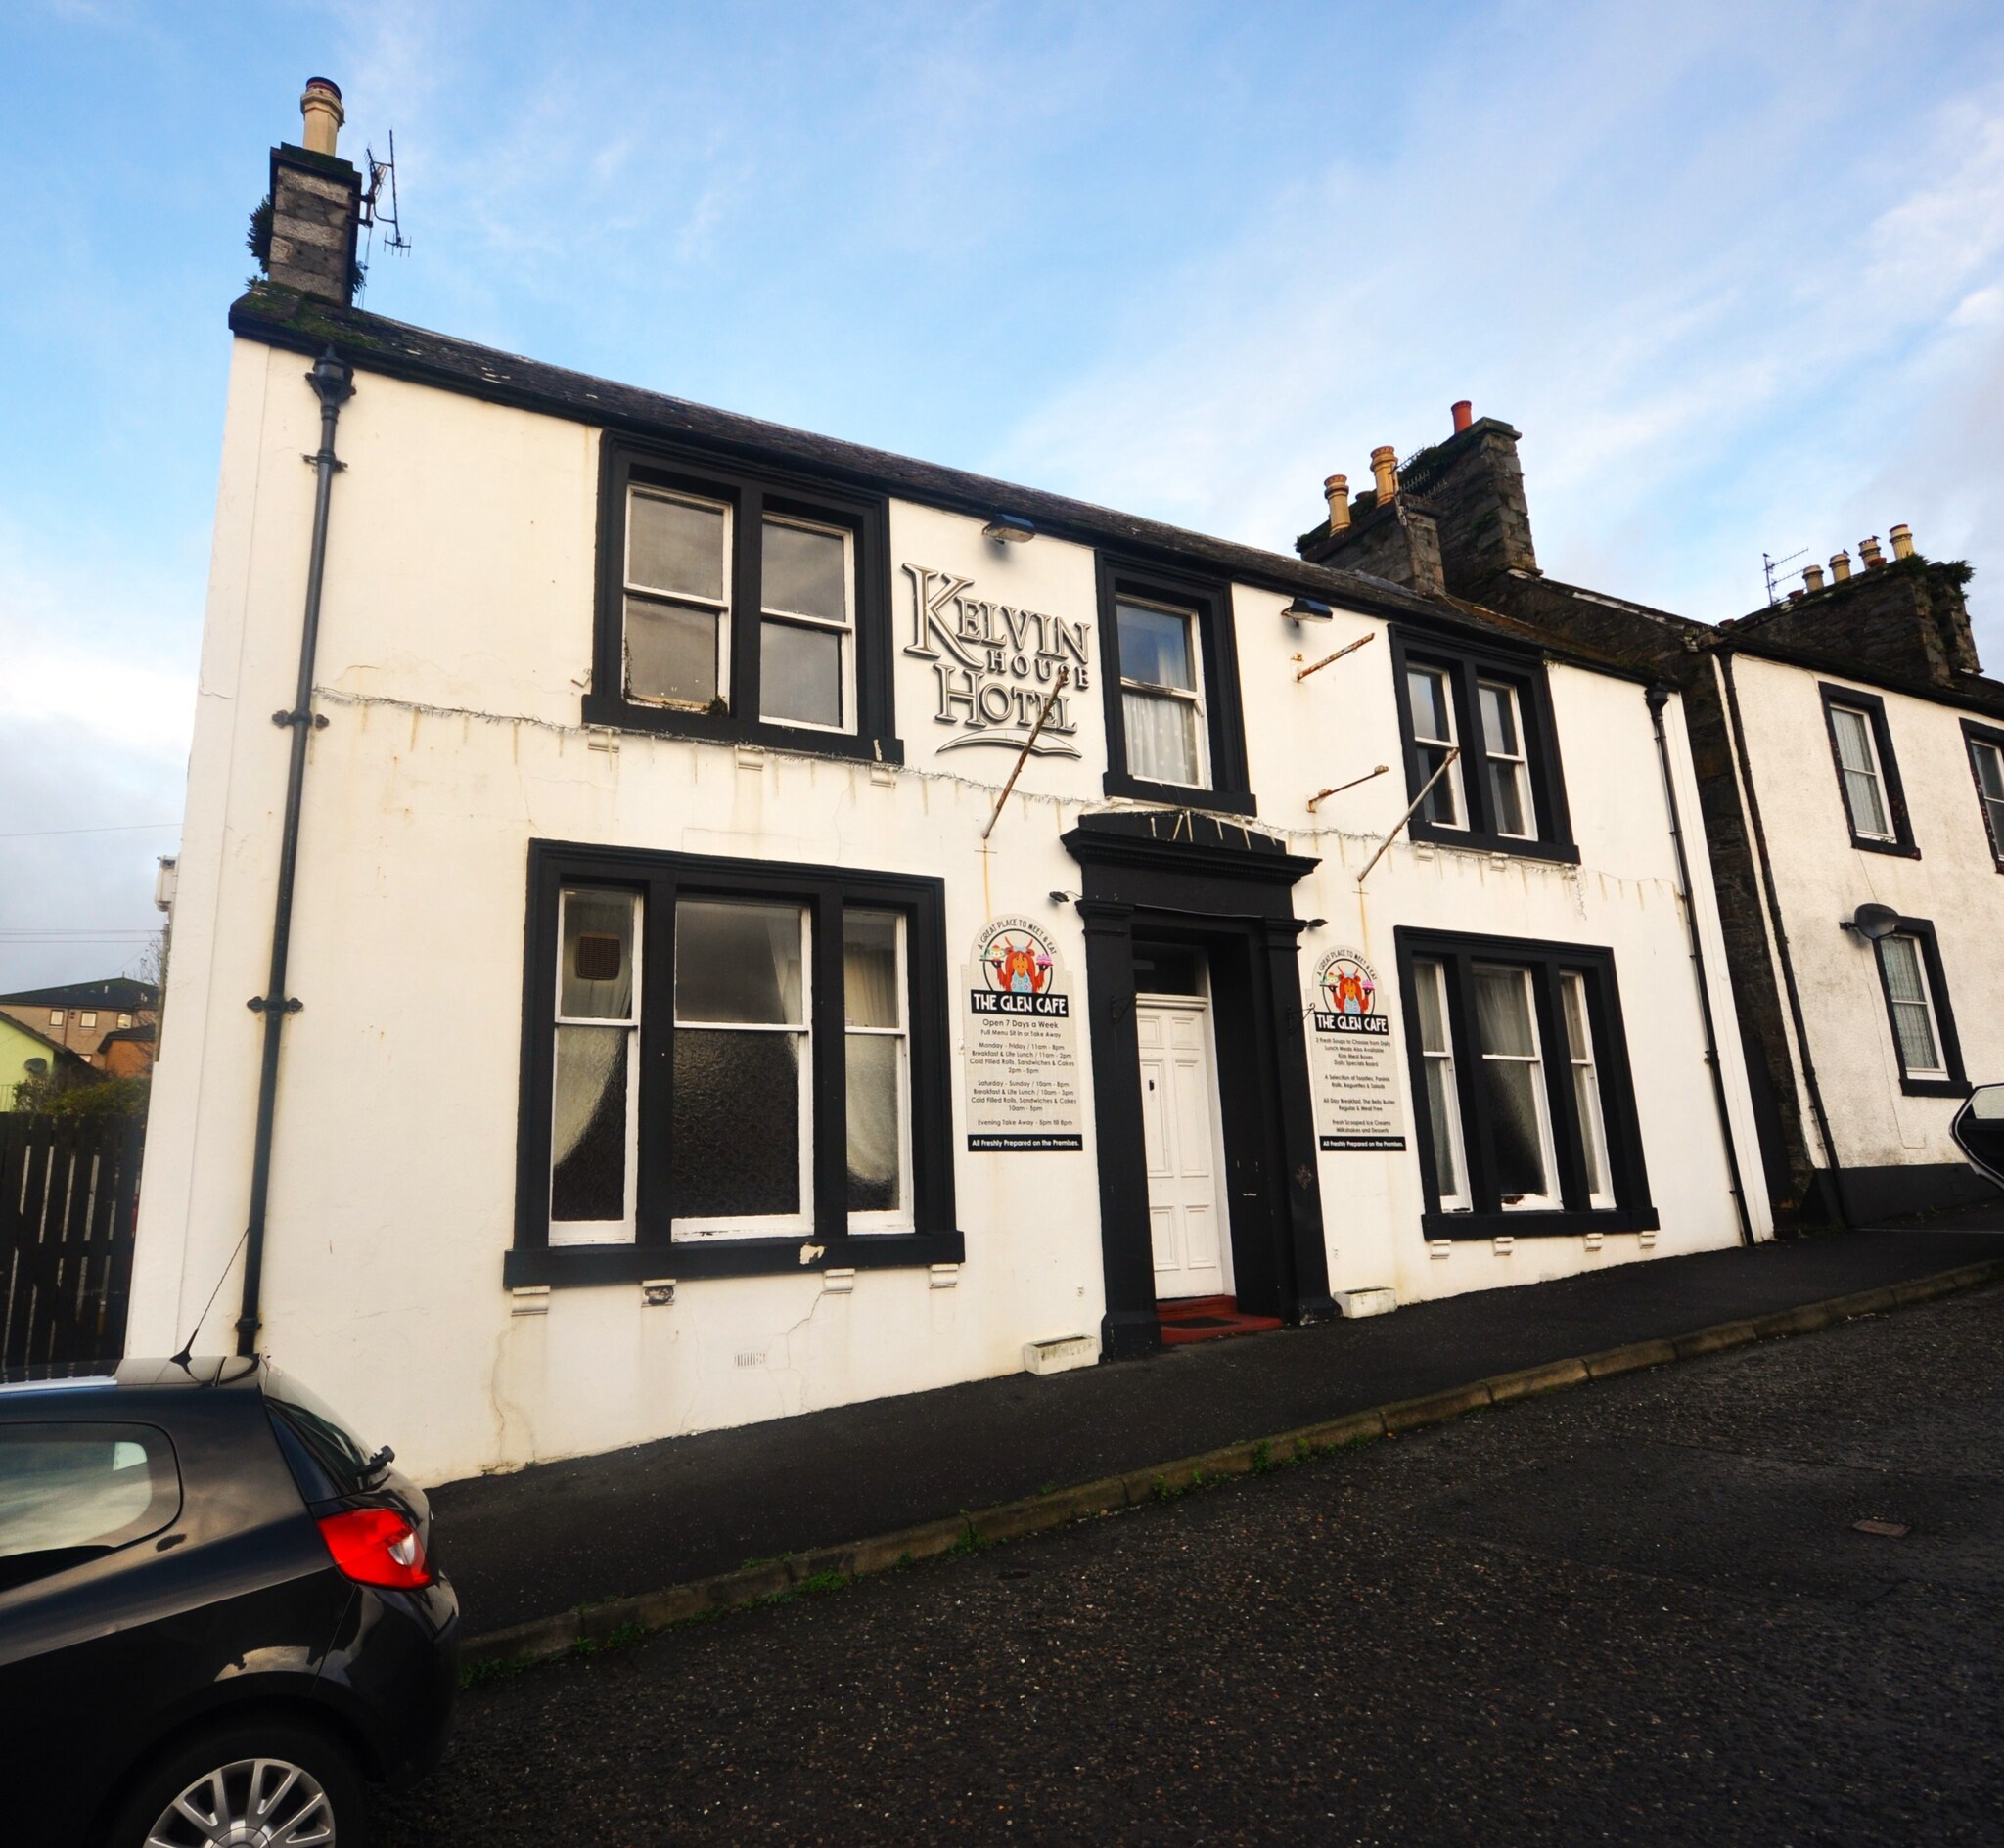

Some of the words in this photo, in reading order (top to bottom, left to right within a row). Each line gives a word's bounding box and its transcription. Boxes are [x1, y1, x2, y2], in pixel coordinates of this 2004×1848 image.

[902, 563, 1091, 669] KELVIN
[987, 650, 1089, 689] HOUSE
[933, 663, 1077, 734] HOTEL
[980, 924, 997, 942] GREAT
[997, 919, 1017, 928] PLACE
[1028, 924, 1044, 937] MEET
[1047, 940, 1057, 955] EAT
[1319, 955, 1331, 970] GREAT
[1331, 949, 1345, 958] PLACE
[974, 994, 997, 1010] THE
[1000, 996, 1032, 1012] GLEN
[1036, 998, 1066, 1014] CAFE
[983, 1018, 1003, 1027] Open
[1316, 1014, 1335, 1029] THE
[1337, 1016, 1362, 1030] GLEN
[1364, 1018, 1387, 1032] CAFE
